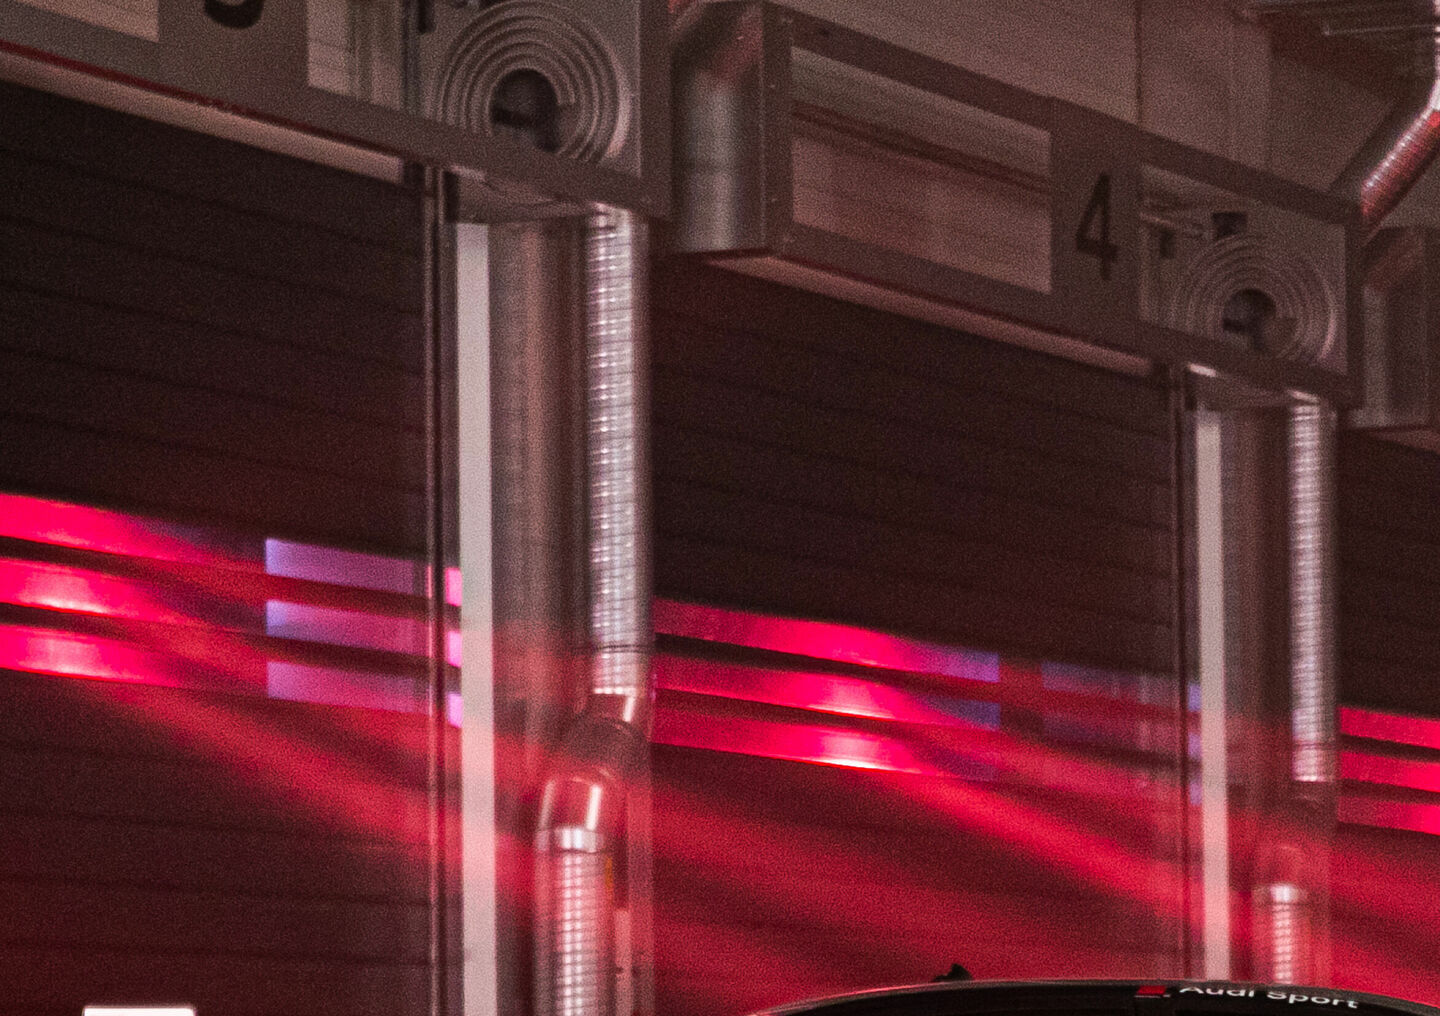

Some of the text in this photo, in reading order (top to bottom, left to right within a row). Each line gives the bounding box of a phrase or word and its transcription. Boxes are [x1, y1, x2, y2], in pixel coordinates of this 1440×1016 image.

[1074, 172, 1118, 282] 4
[1179, 986, 1360, 1009] Audi Sport
